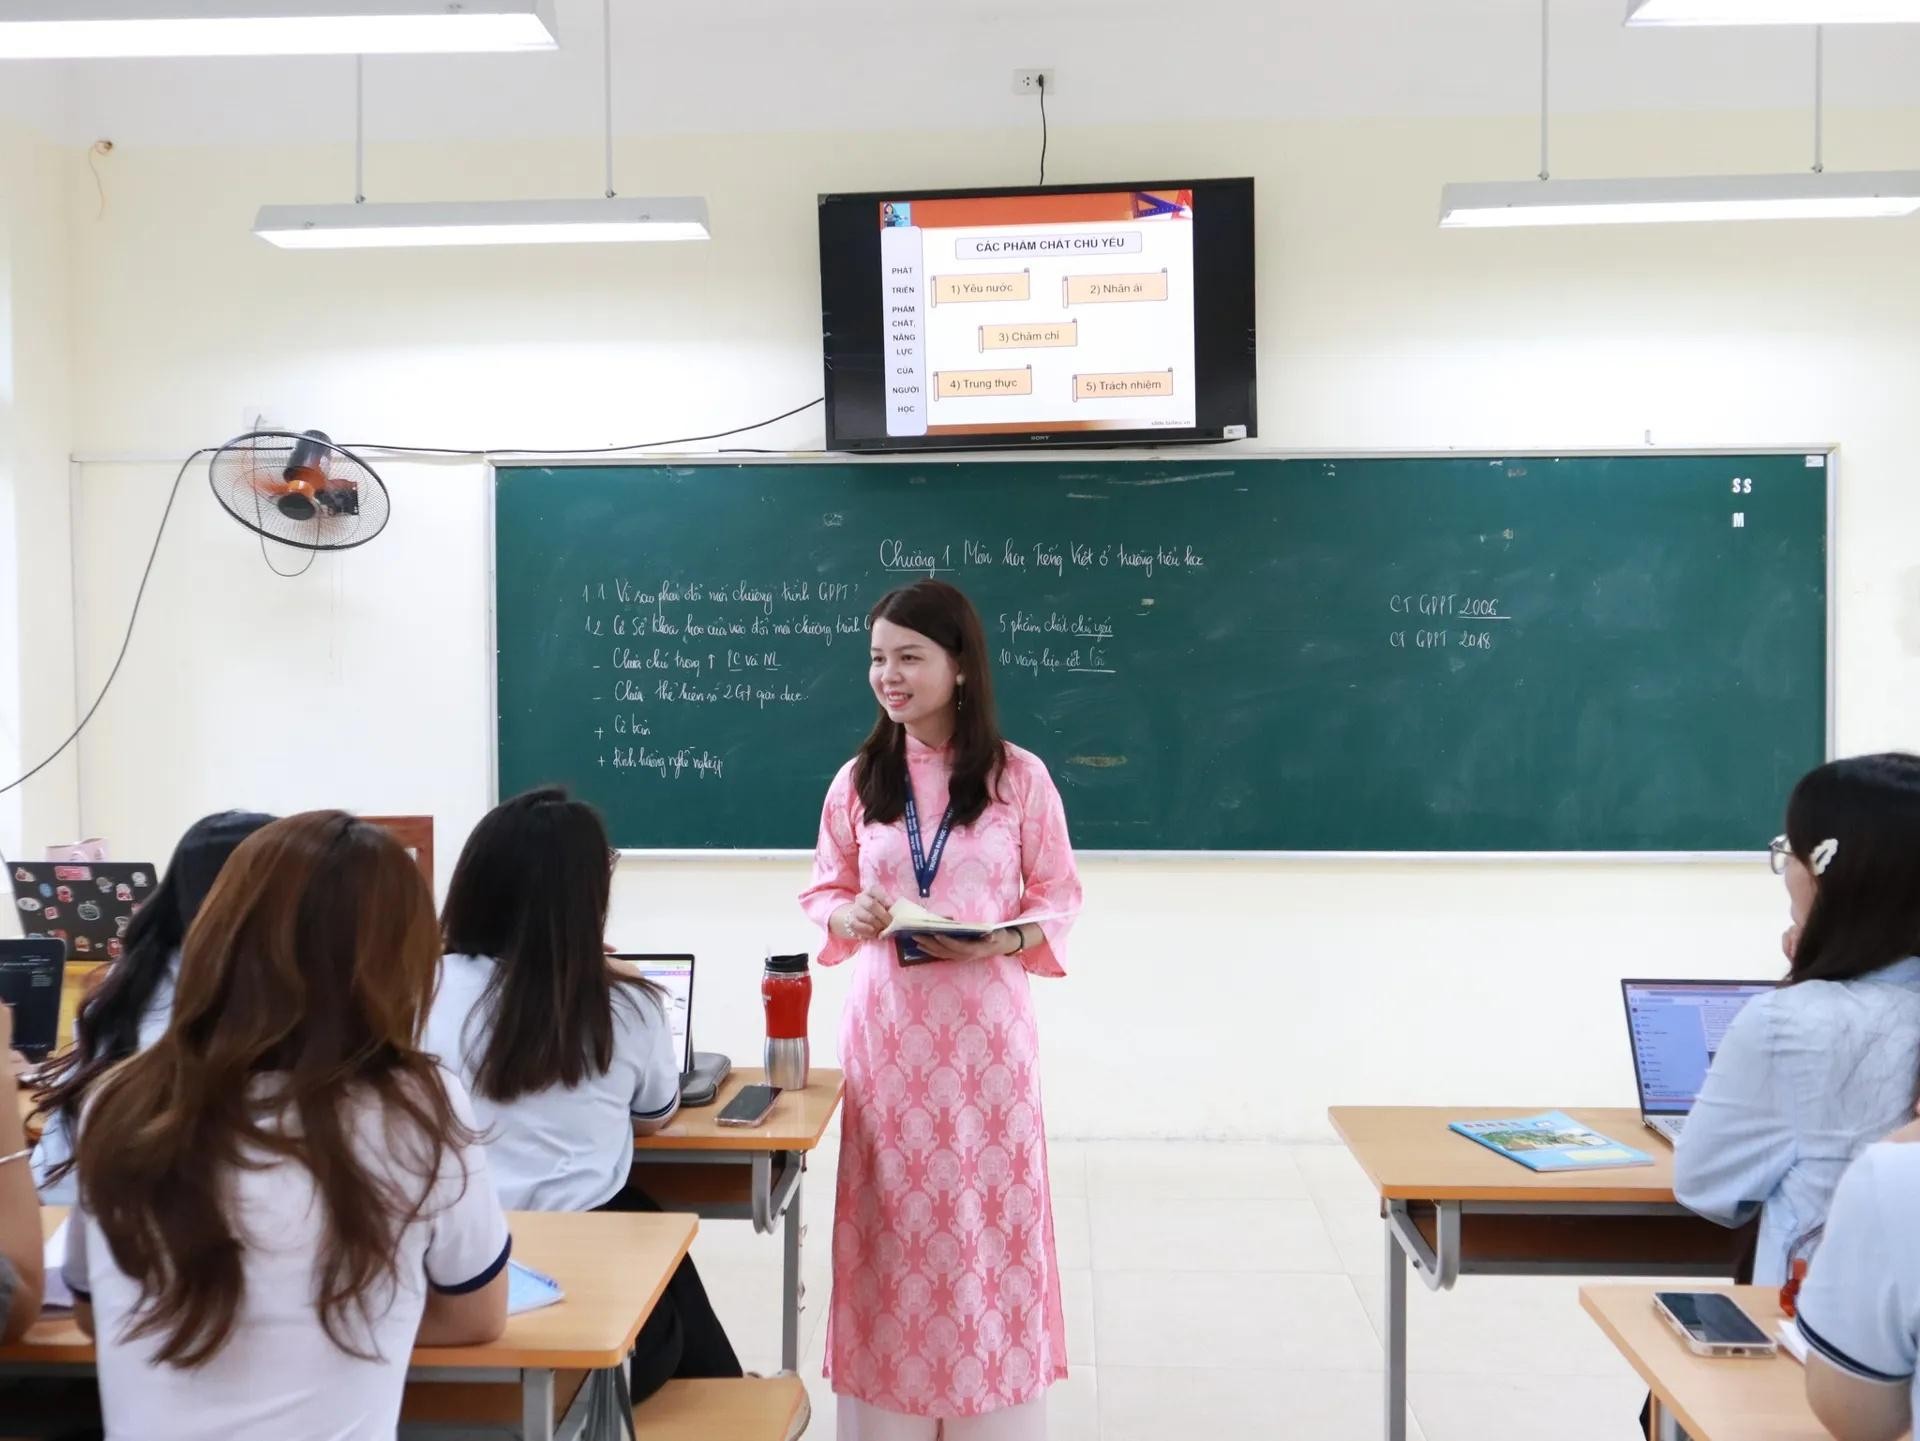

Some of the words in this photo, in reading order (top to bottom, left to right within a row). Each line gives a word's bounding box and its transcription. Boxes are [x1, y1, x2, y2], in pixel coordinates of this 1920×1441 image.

[976, 240, 1000, 252] CÁC
[1074, 236, 1098, 248] CHỦ
[951, 285, 961, 295] 1)
[963, 283, 983, 293] Yêu
[985, 283, 1013, 293] nước
[1090, 285, 1101, 295] 2)
[1102, 283, 1130, 293] Nhân
[998, 332, 1009, 343] 3)
[1011, 331, 1042, 341] Chăm
[950, 381, 961, 391] 4)
[963, 379, 992, 390] Trung
[995, 378, 1018, 390] thực
[1086, 382, 1097, 392] 5)
[1099, 380, 1128, 391] Trách
[1130, 380, 1162, 391] nhiệm
[1733, 512, 1744, 528] M
[964, 538, 993, 565] Môn
[1390, 594, 1412, 613] CT
[1000, 612, 1006, 632] 5
[1459, 630, 1492, 650] 2018
[763, 650, 782, 667] NL
[999, 647, 1011, 667] 10
